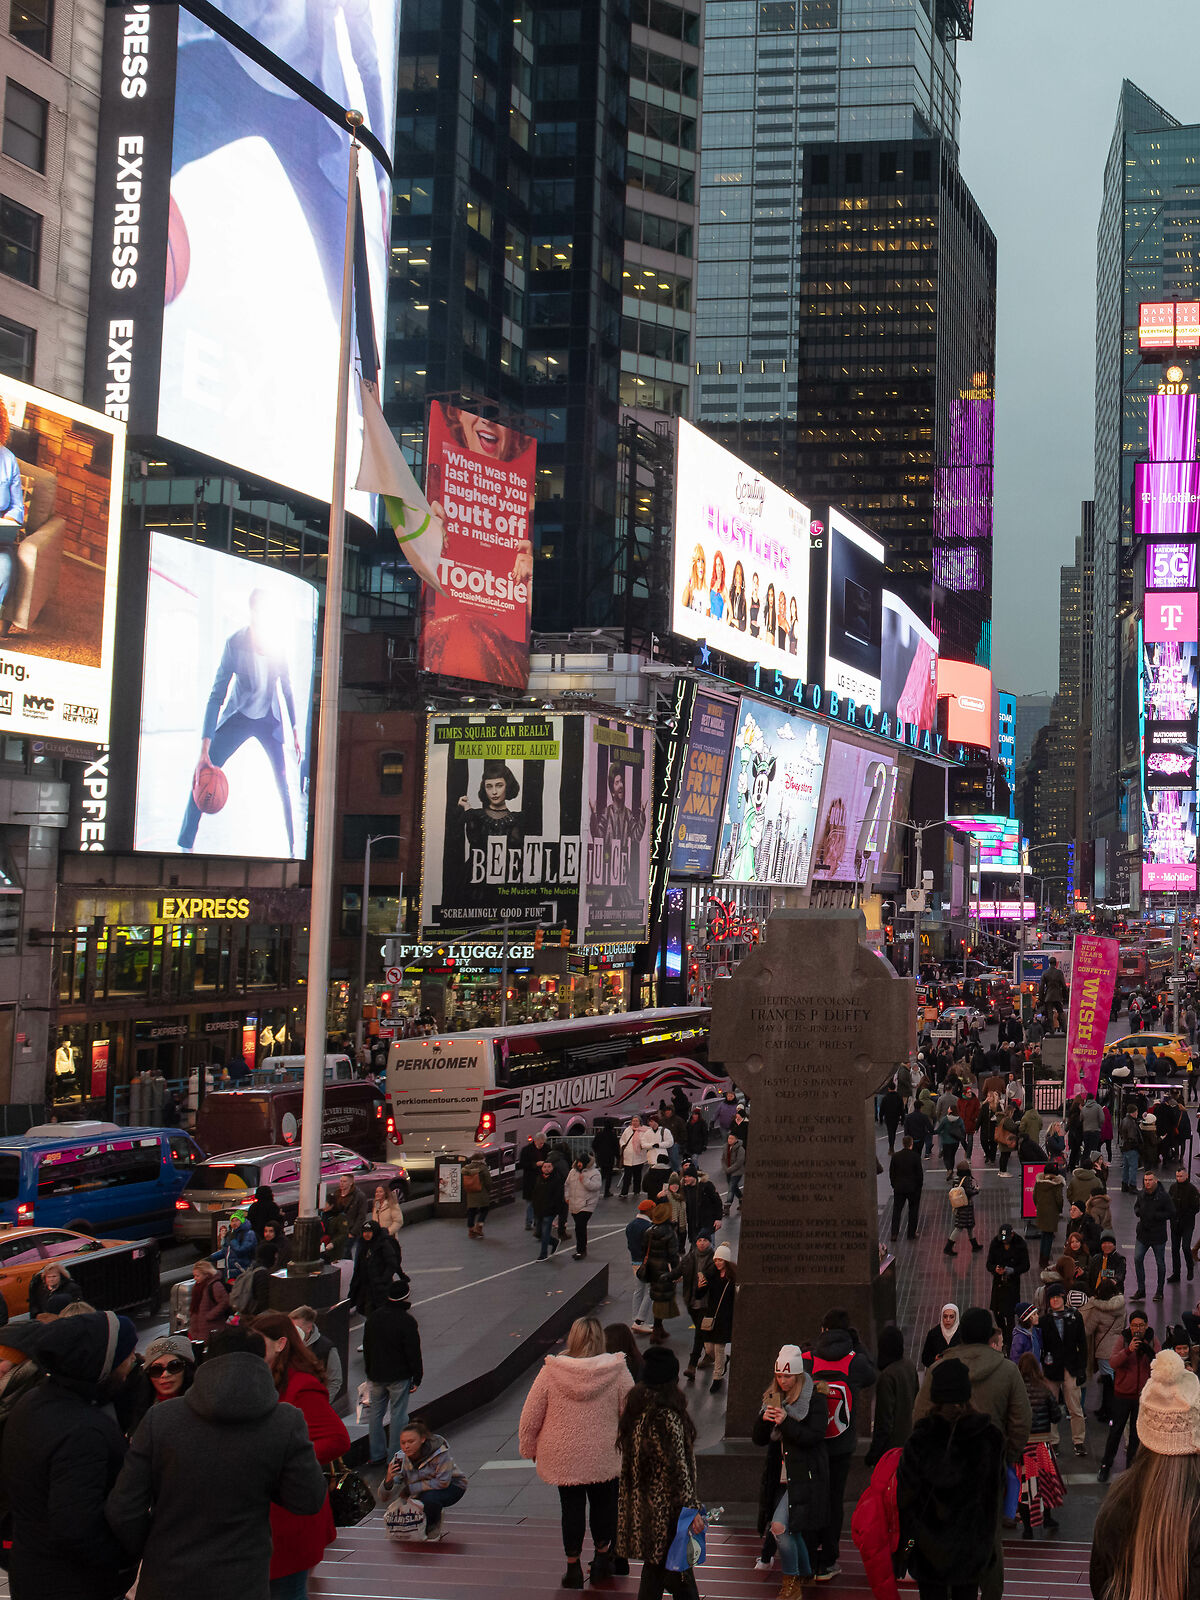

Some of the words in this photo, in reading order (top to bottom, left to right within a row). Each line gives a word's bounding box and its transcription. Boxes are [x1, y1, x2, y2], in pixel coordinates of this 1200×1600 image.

[111, 135, 144, 290] EXPRESS
[1143, 307, 1197, 315] BARNEYS
[1143, 316, 1166, 324] NEW
[1167, 316, 1197, 324] YORK
[104, 319, 135, 422] EXPRE
[1157, 383, 1189, 396] 2019
[445, 463, 469, 484] last
[473, 474, 502, 494] time
[504, 485, 527, 502] you
[485, 466, 507, 482] was
[509, 472, 527, 488] the
[444, 479, 497, 508] laughed
[499, 498, 527, 516] your
[443, 495, 492, 529] butt
[495, 515, 527, 538] off
[447, 522, 460, 534] at
[461, 526, 469, 537] a
[809, 539, 823, 549] LG
[1153, 552, 1189, 578] 5G
[440, 556, 527, 604] Tootsie
[1158, 665, 1183, 682] 5G
[23, 694, 54, 711] NYC
[562, 690, 597, 699] LAMAR
[63, 704, 99, 719] READY
[63, 715, 78, 723] NEW
[80, 717, 98, 725] YORK
[829, 690, 943, 754] BROADWAY
[437, 727, 463, 740] TIMES
[464, 727, 497, 739] SQUARE
[499, 726, 516, 738] CAN
[518, 724, 550, 737] REALLY
[458, 744, 484, 756] MAKE
[485, 744, 503, 756] YOU
[505, 744, 527, 756] FEEL
[528, 743, 557, 756] ALIVE!
[661, 740, 678, 797] MAC
[690, 750, 725, 777] COME
[682, 793, 719, 817] AWAY
[865, 761, 900, 854] 21
[652, 802, 668, 859] MAC
[498, 886, 510, 897] The
[540, 887, 553, 896] The
[162, 898, 251, 920] EXPRESS
[499, 907, 523, 918] GOOD
[447, 944, 535, 960] LUGGAGE
[604, 944, 636, 956] LUGGAGE
[1077, 966, 1111, 976] CONFETTI
[751, 1009, 806, 1022] FRANCIS
[810, 1009, 819, 1021] P
[824, 1009, 872, 1022] DUFFY
[1078, 977, 1101, 1041] WISH
[151, 1025, 189, 1038] EXPRESS
[205, 1020, 240, 1032] EXPRESS
[819, 1040, 854, 1050] PRIEST
[395, 1056, 478, 1072] PERKIOMEN
[785, 1064, 833, 1074] CHAPLAIN
[396, 1095, 479, 1107] perkiomentours.com
[518, 1072, 618, 1117] PERKIOMEN
[809, 1134, 856, 1144] COUNTRY
[449, 1167, 462, 1200] FROZEN
[775, 1361, 791, 1373] LA
